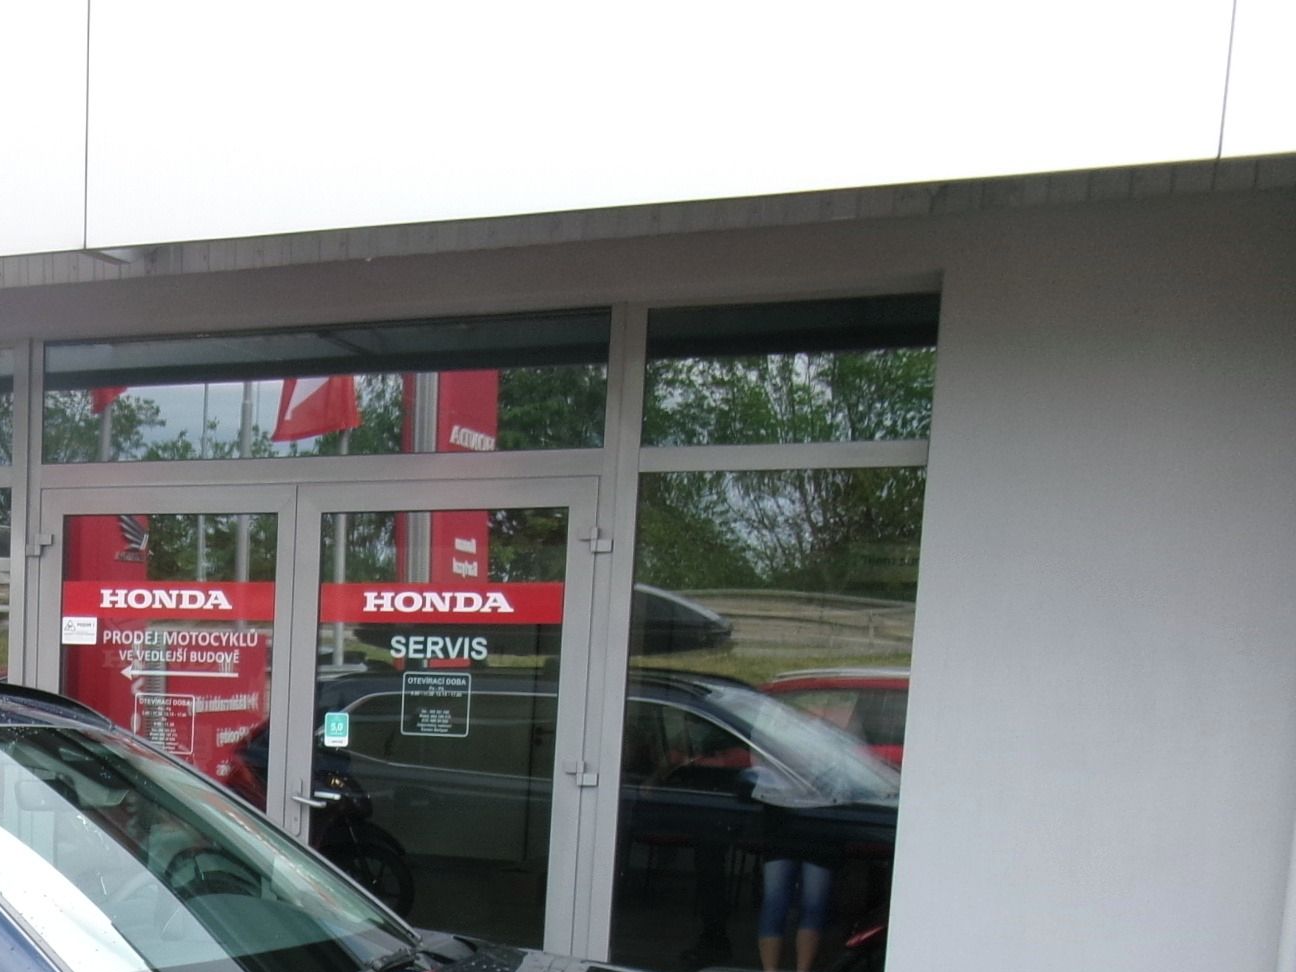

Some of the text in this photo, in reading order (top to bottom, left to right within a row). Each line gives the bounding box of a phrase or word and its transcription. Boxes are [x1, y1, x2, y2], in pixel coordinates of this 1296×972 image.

[100, 589, 232, 610] HONDA
[363, 591, 515, 613] HONDA
[103, 628, 258, 647] PRODEJ MOTOCYKLŮ
[390, 635, 488, 660] SERVIS
[119, 648, 239, 663] VE VEDLEJŠÍ BUDOVĚ
[445, 678, 466, 686] DOBA
